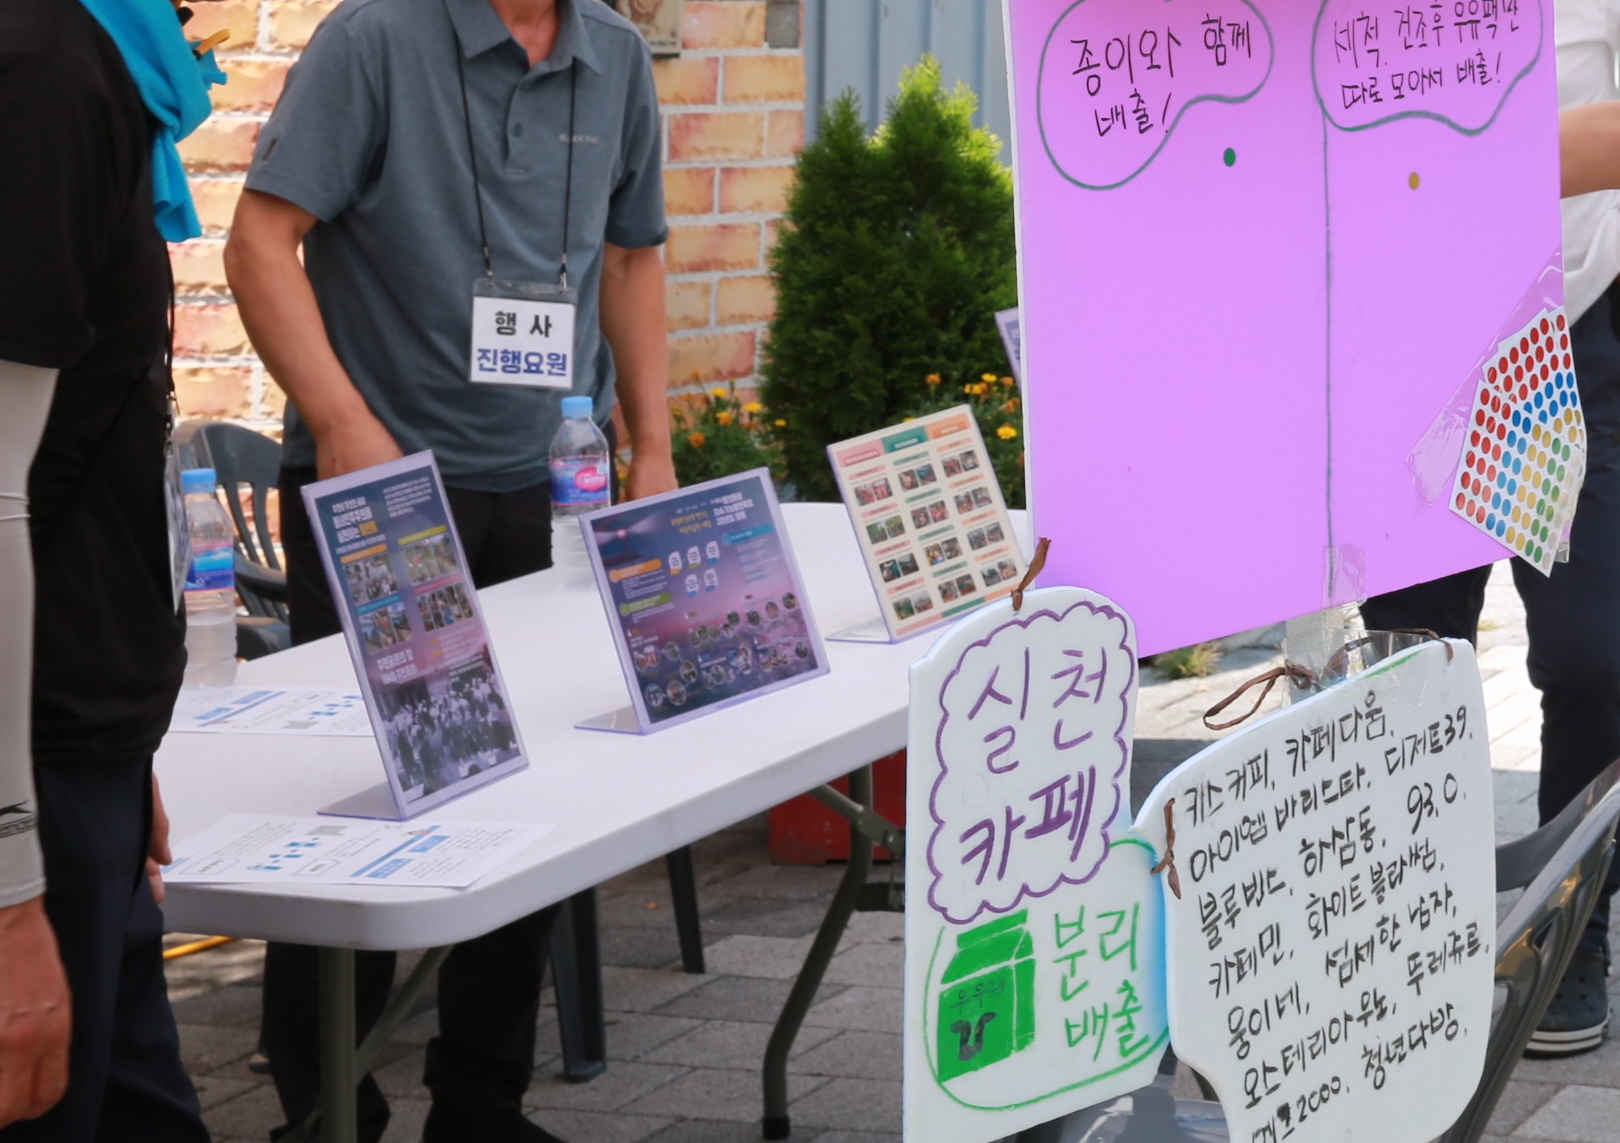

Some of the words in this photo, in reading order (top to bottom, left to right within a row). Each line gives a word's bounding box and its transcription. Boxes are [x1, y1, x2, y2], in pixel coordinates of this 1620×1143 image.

[1070, 25, 1182, 96] 종이와
[1200, 12, 1253, 66] 함께
[1341, 76, 1383, 110] 따로
[1391, 66, 1444, 100] 모아서
[1094, 87, 1173, 136] 배출!
[476, 348, 568, 377] 진행요원
[967, 645, 1108, 775] 실천
[959, 765, 1097, 886] 카페
[1052, 901, 1141, 1001] 분리
[1063, 979, 1153, 1063] 배출
